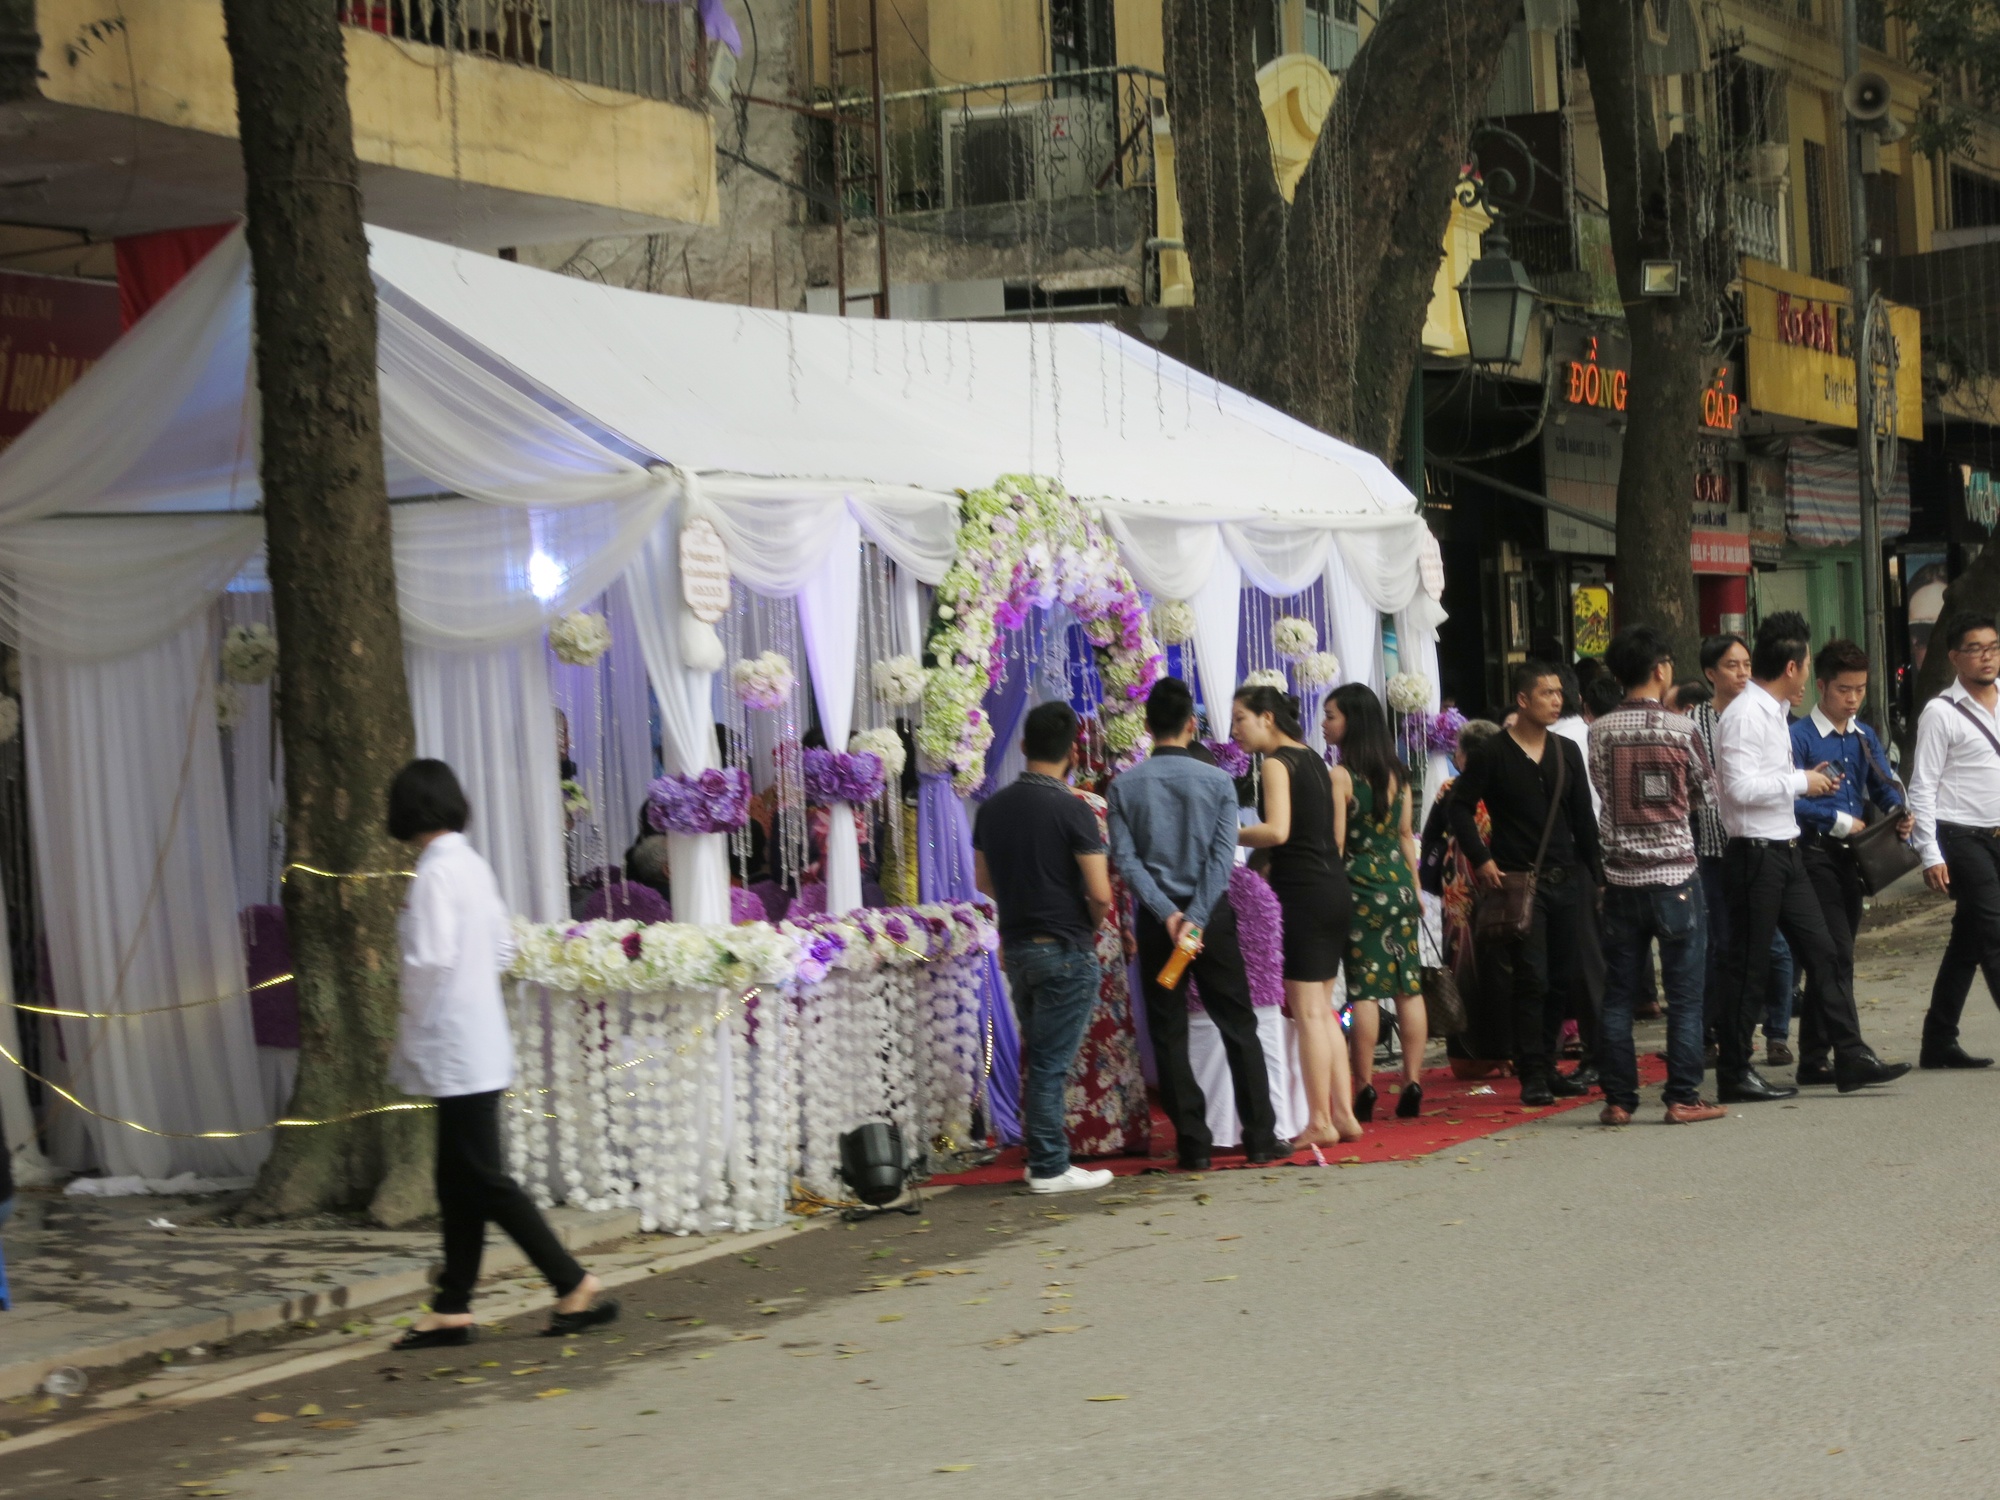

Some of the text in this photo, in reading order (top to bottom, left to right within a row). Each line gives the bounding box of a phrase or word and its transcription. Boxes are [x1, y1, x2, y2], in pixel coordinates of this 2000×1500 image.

[1777, 290, 1835, 355] Kodak
[1569, 335, 1628, 411] ĐỒNG
[1704, 367, 1739, 430] CẤP
